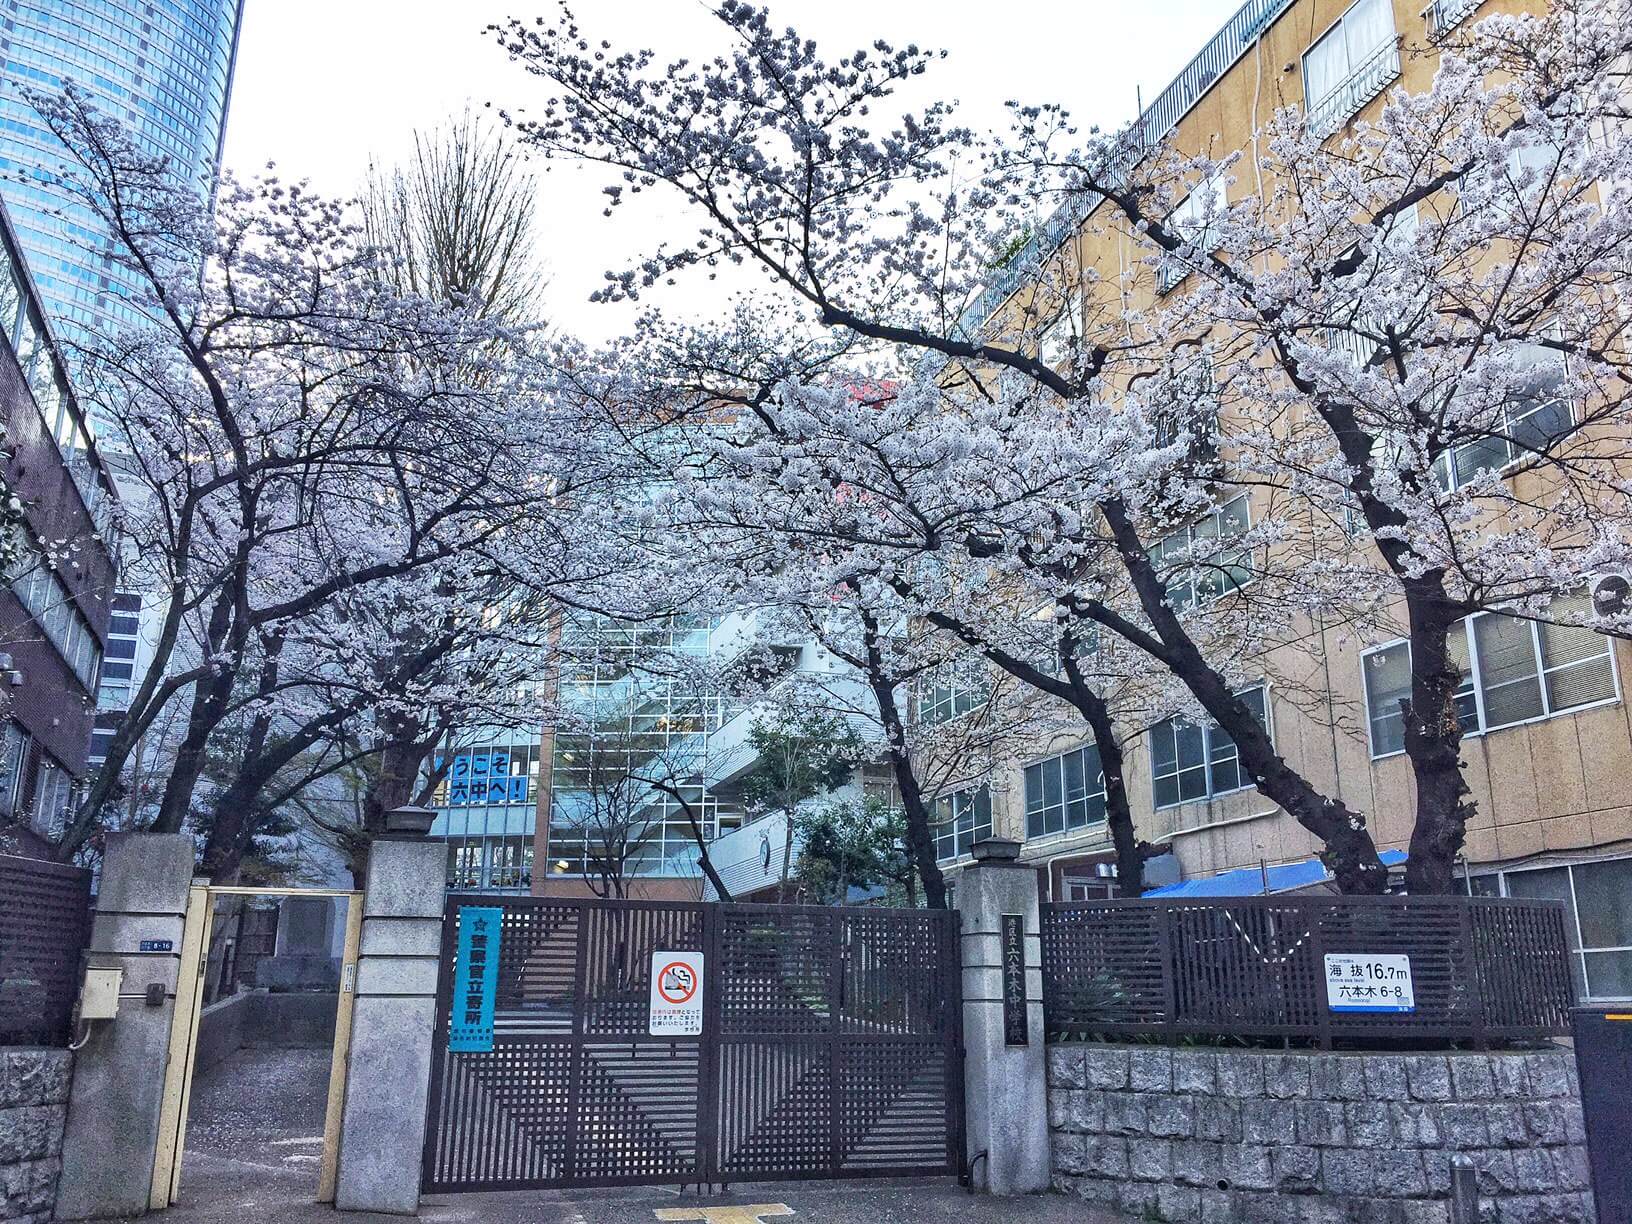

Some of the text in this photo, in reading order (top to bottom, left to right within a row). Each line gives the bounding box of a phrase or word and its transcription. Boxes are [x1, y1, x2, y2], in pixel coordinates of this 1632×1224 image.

[446, 756, 508, 775] うこそ
[452, 780, 521, 799] 六中へ！
[1006, 918, 1023, 1042] 港区立六本木中学校
[1366, 963, 1408, 979] 16.7m
[1339, 985, 1403, 998] 六本木 6-8
